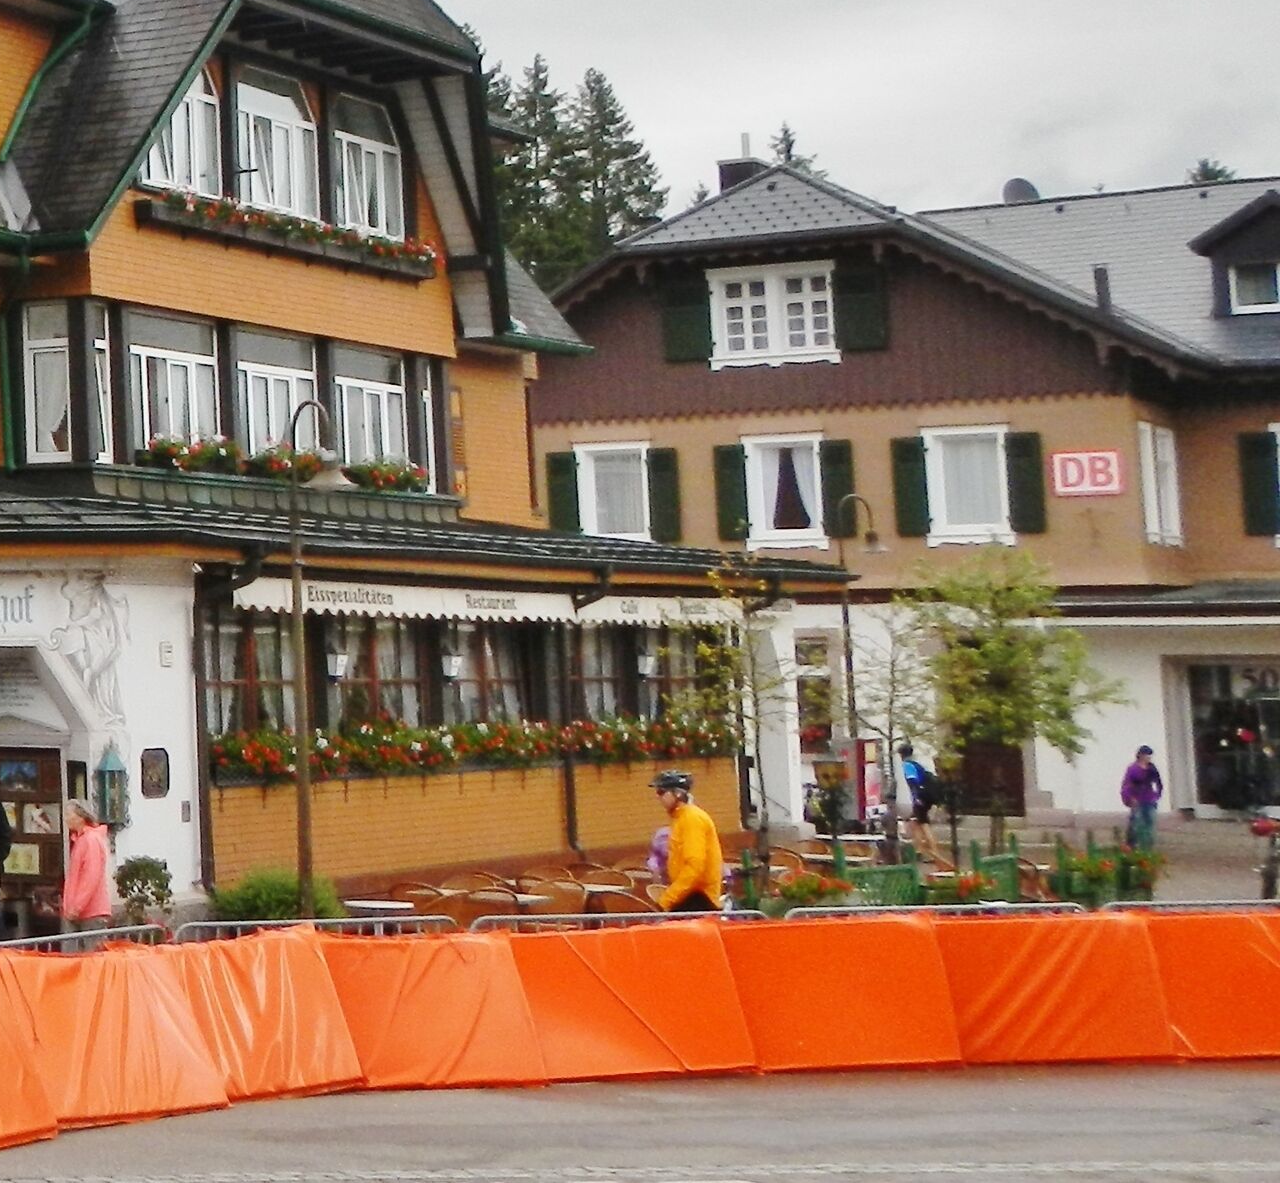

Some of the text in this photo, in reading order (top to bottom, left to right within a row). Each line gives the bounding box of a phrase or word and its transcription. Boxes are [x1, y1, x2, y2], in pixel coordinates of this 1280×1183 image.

[1059, 456, 1114, 488] DB
[307, 585, 394, 606] Eisspezialitäten
[465, 593, 518, 610] Restaurant
